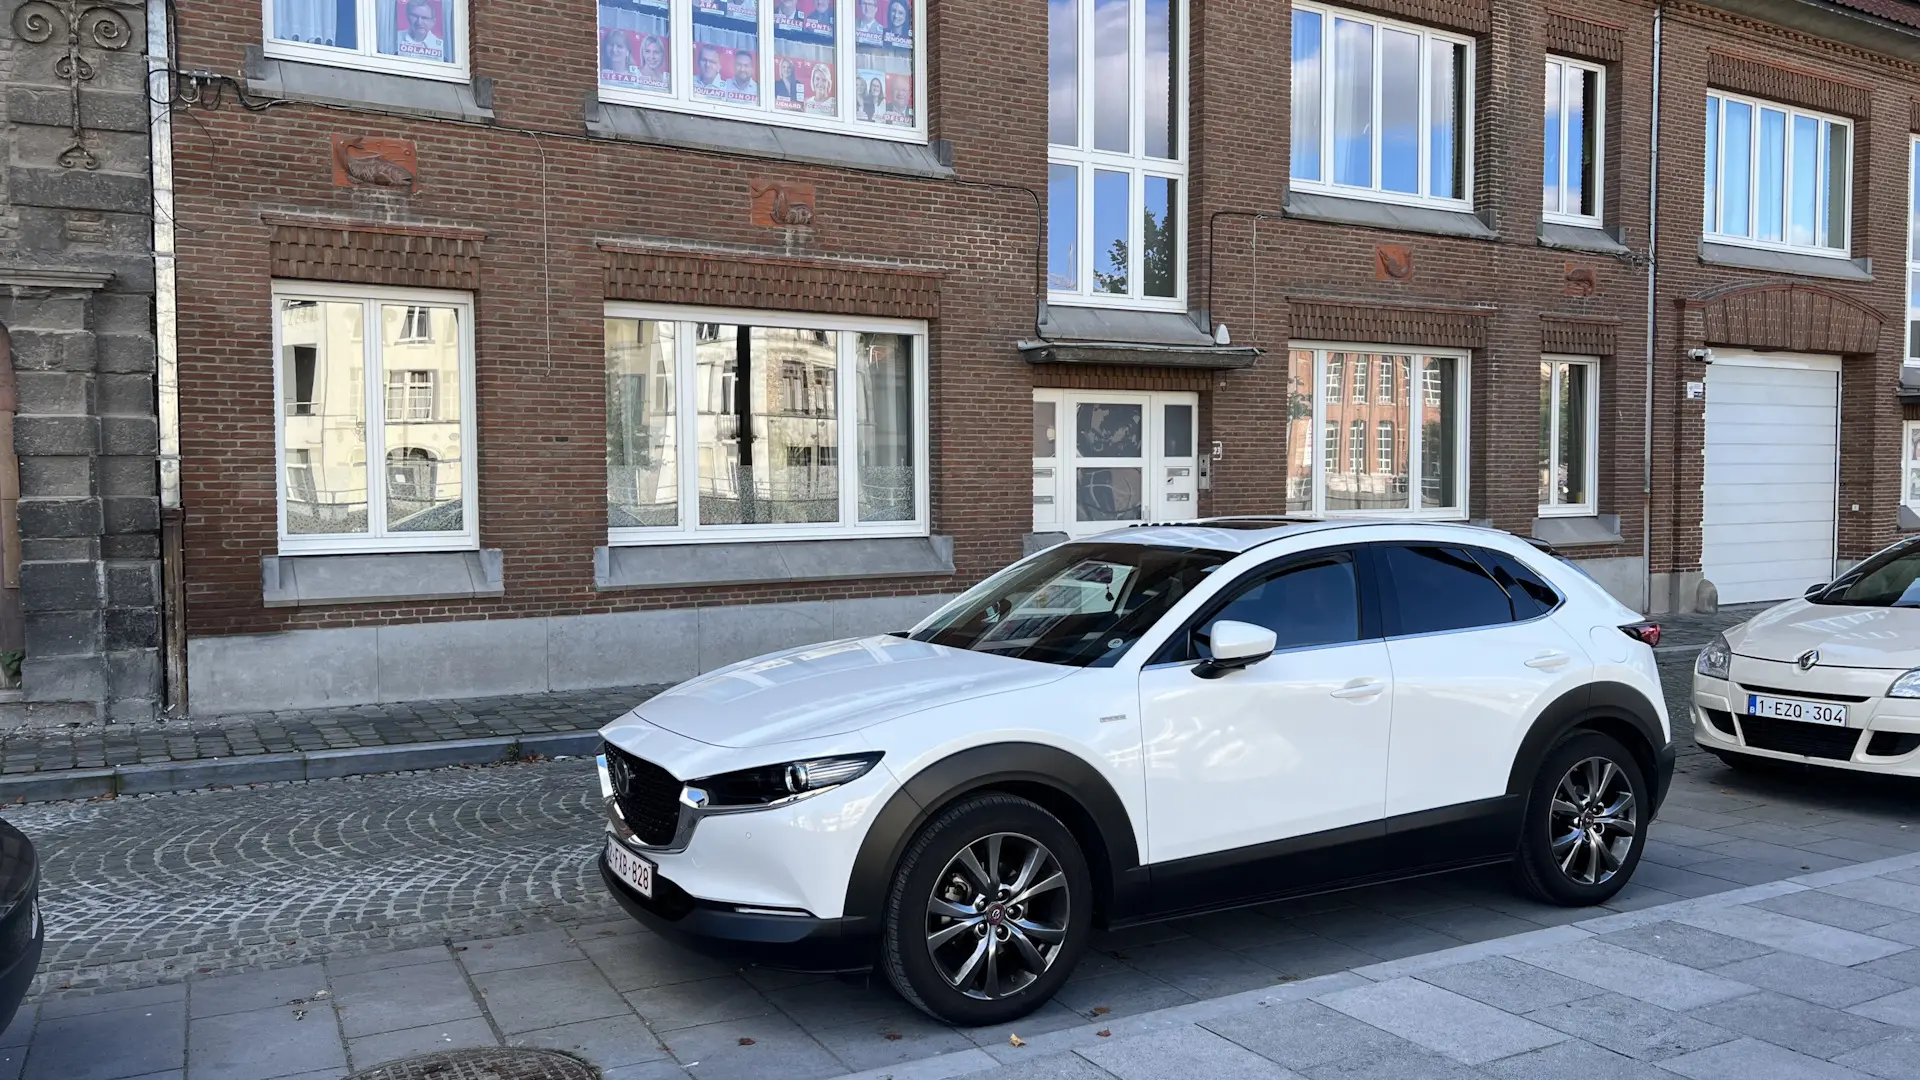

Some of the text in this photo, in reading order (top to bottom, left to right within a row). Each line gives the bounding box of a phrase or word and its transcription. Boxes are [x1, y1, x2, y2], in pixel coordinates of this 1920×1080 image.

[774, 17, 803, 28] ENELLE
[400, 45, 442, 57] ORLANDI
[1759, 700, 1843, 724] 1-EZQ-304
